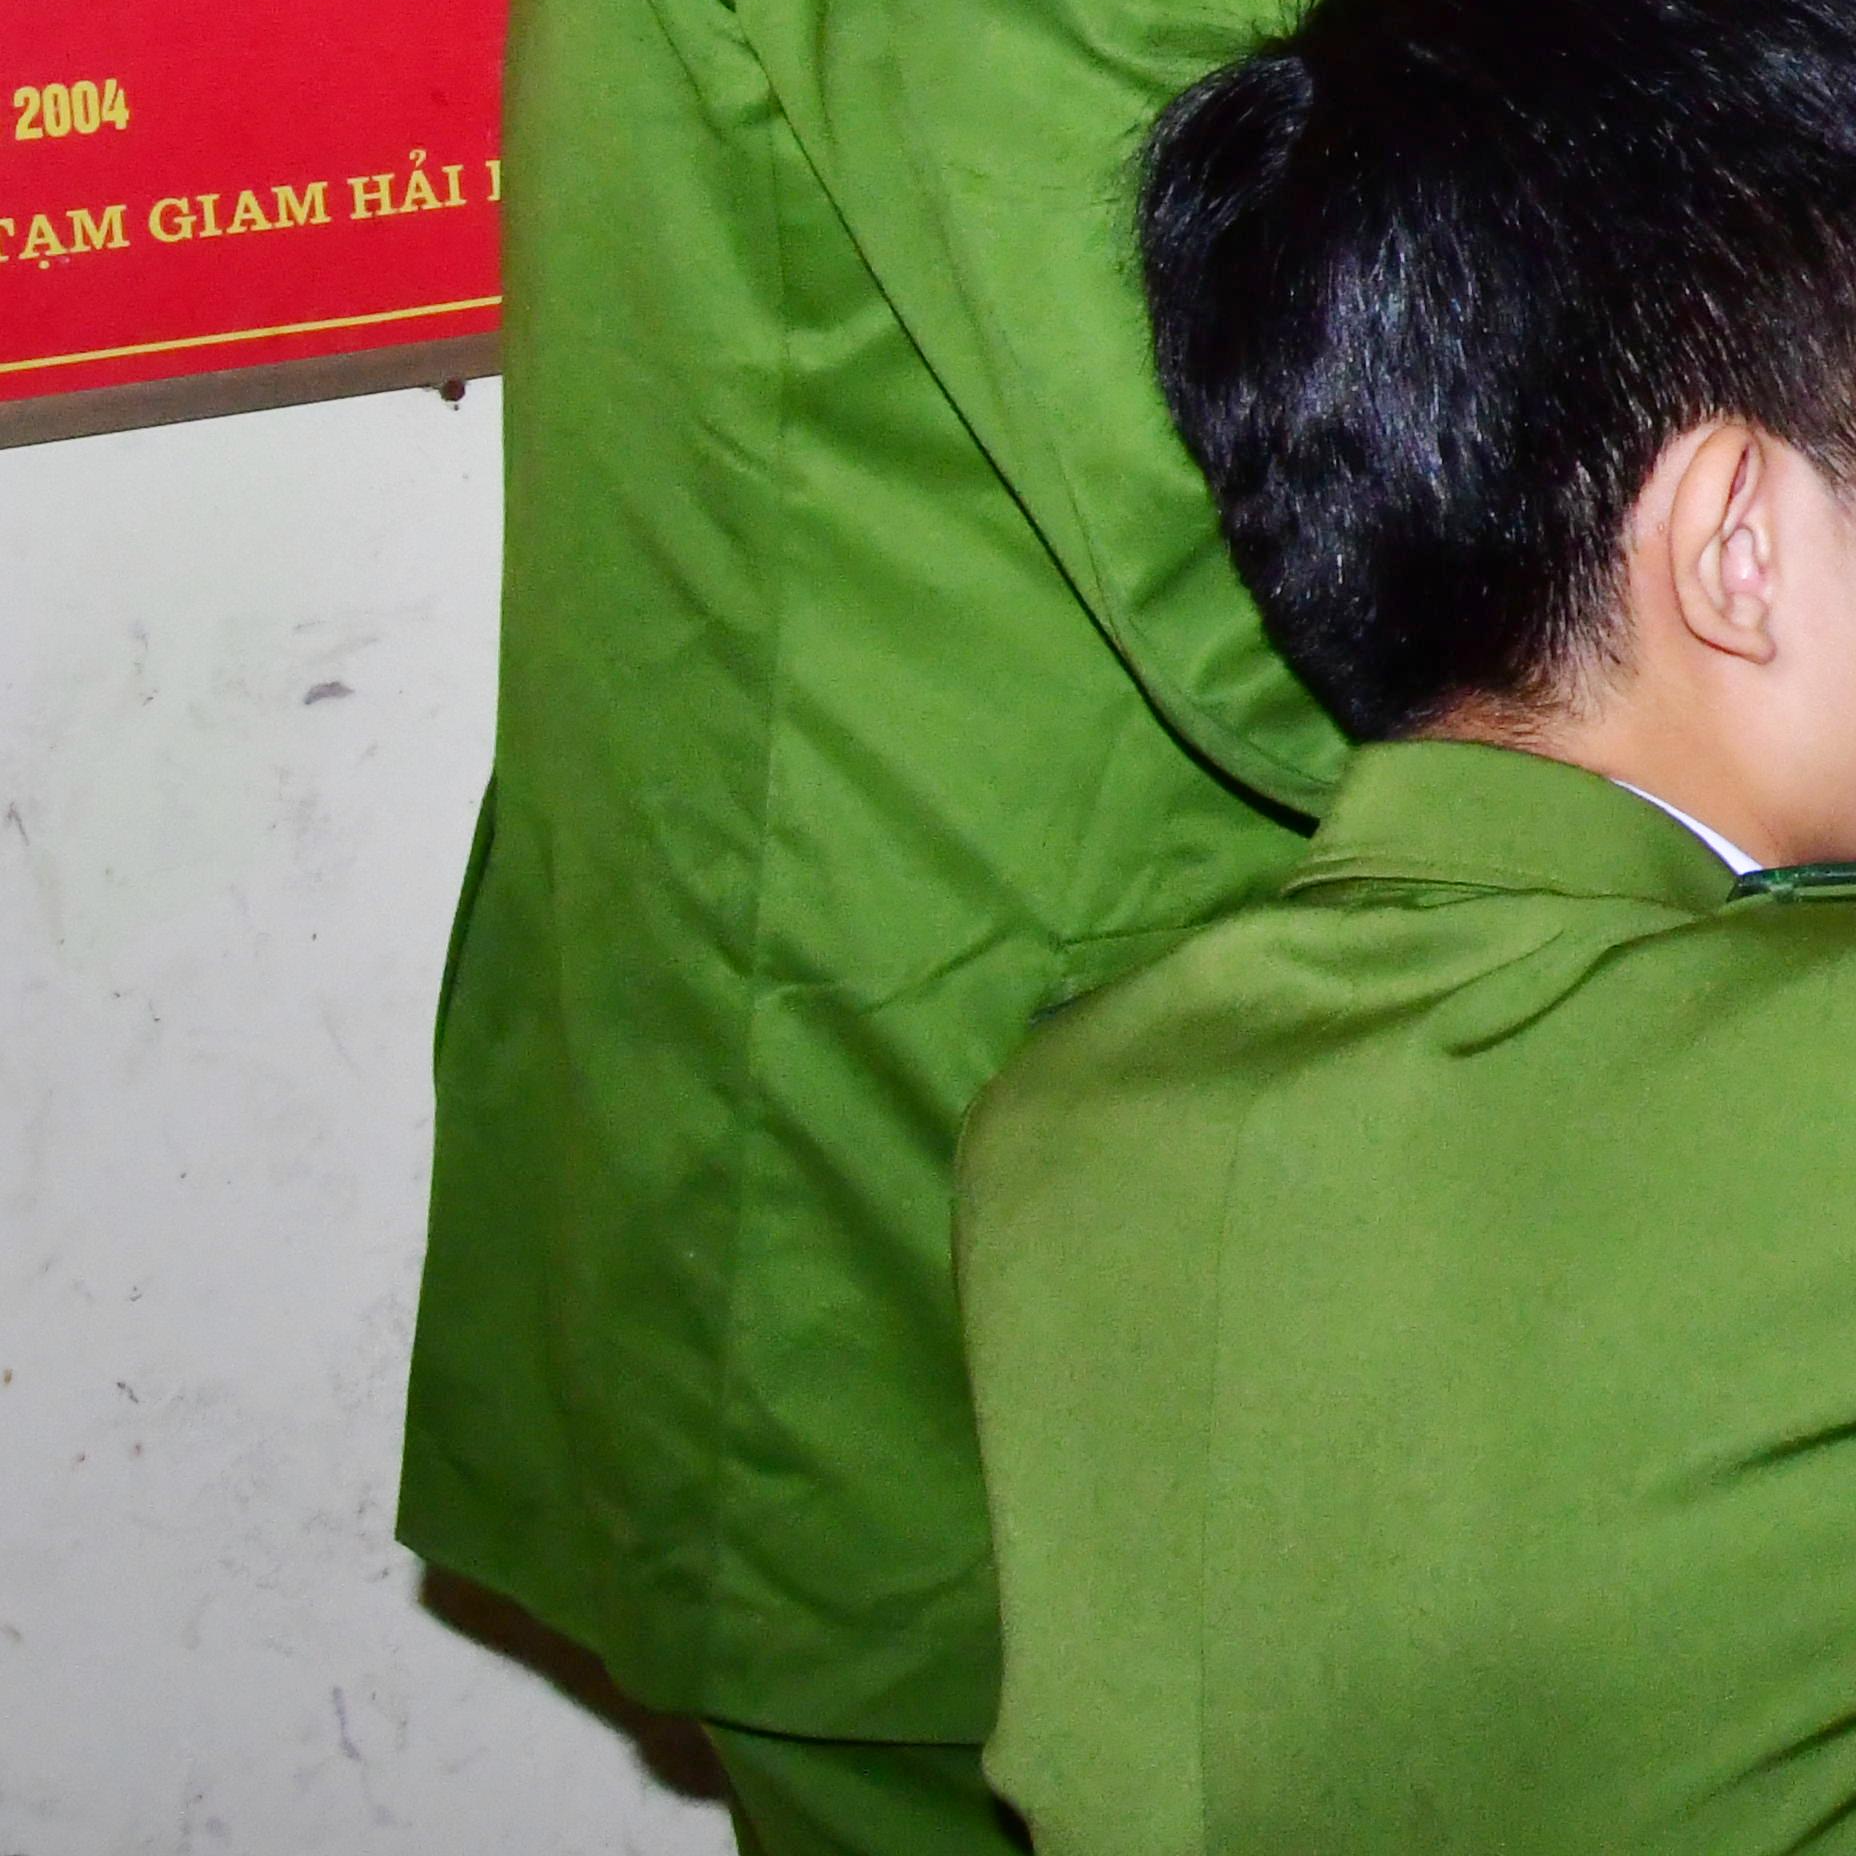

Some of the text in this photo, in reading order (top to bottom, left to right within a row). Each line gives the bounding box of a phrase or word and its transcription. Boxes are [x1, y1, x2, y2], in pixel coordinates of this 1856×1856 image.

[11, 77, 131, 142] 2004
[147, 180, 332, 244] GIAM
[348, 148, 468, 220] HẢI
